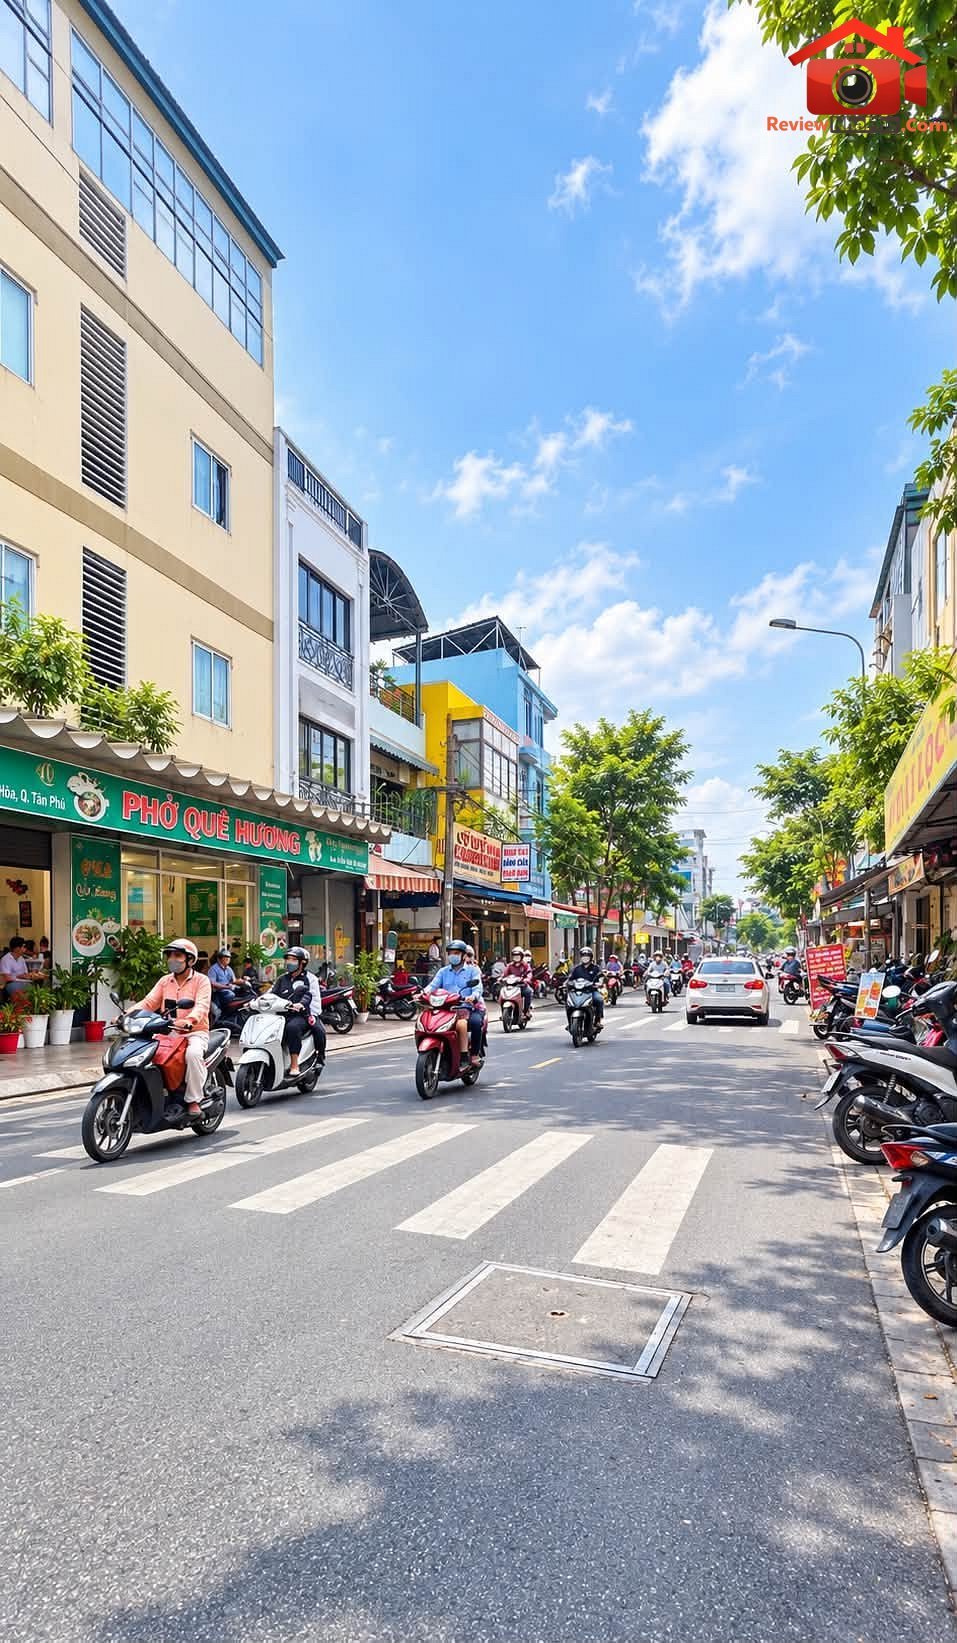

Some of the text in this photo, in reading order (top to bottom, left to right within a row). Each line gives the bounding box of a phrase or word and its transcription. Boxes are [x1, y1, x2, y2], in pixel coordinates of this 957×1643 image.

[20, 789, 30, 803] Q.
[31, 792, 48, 808] Tân
[122, 790, 179, 831] PHỞ
[183, 806, 230, 841] QUÊ
[234, 818, 301, 856] HƯƠNG
